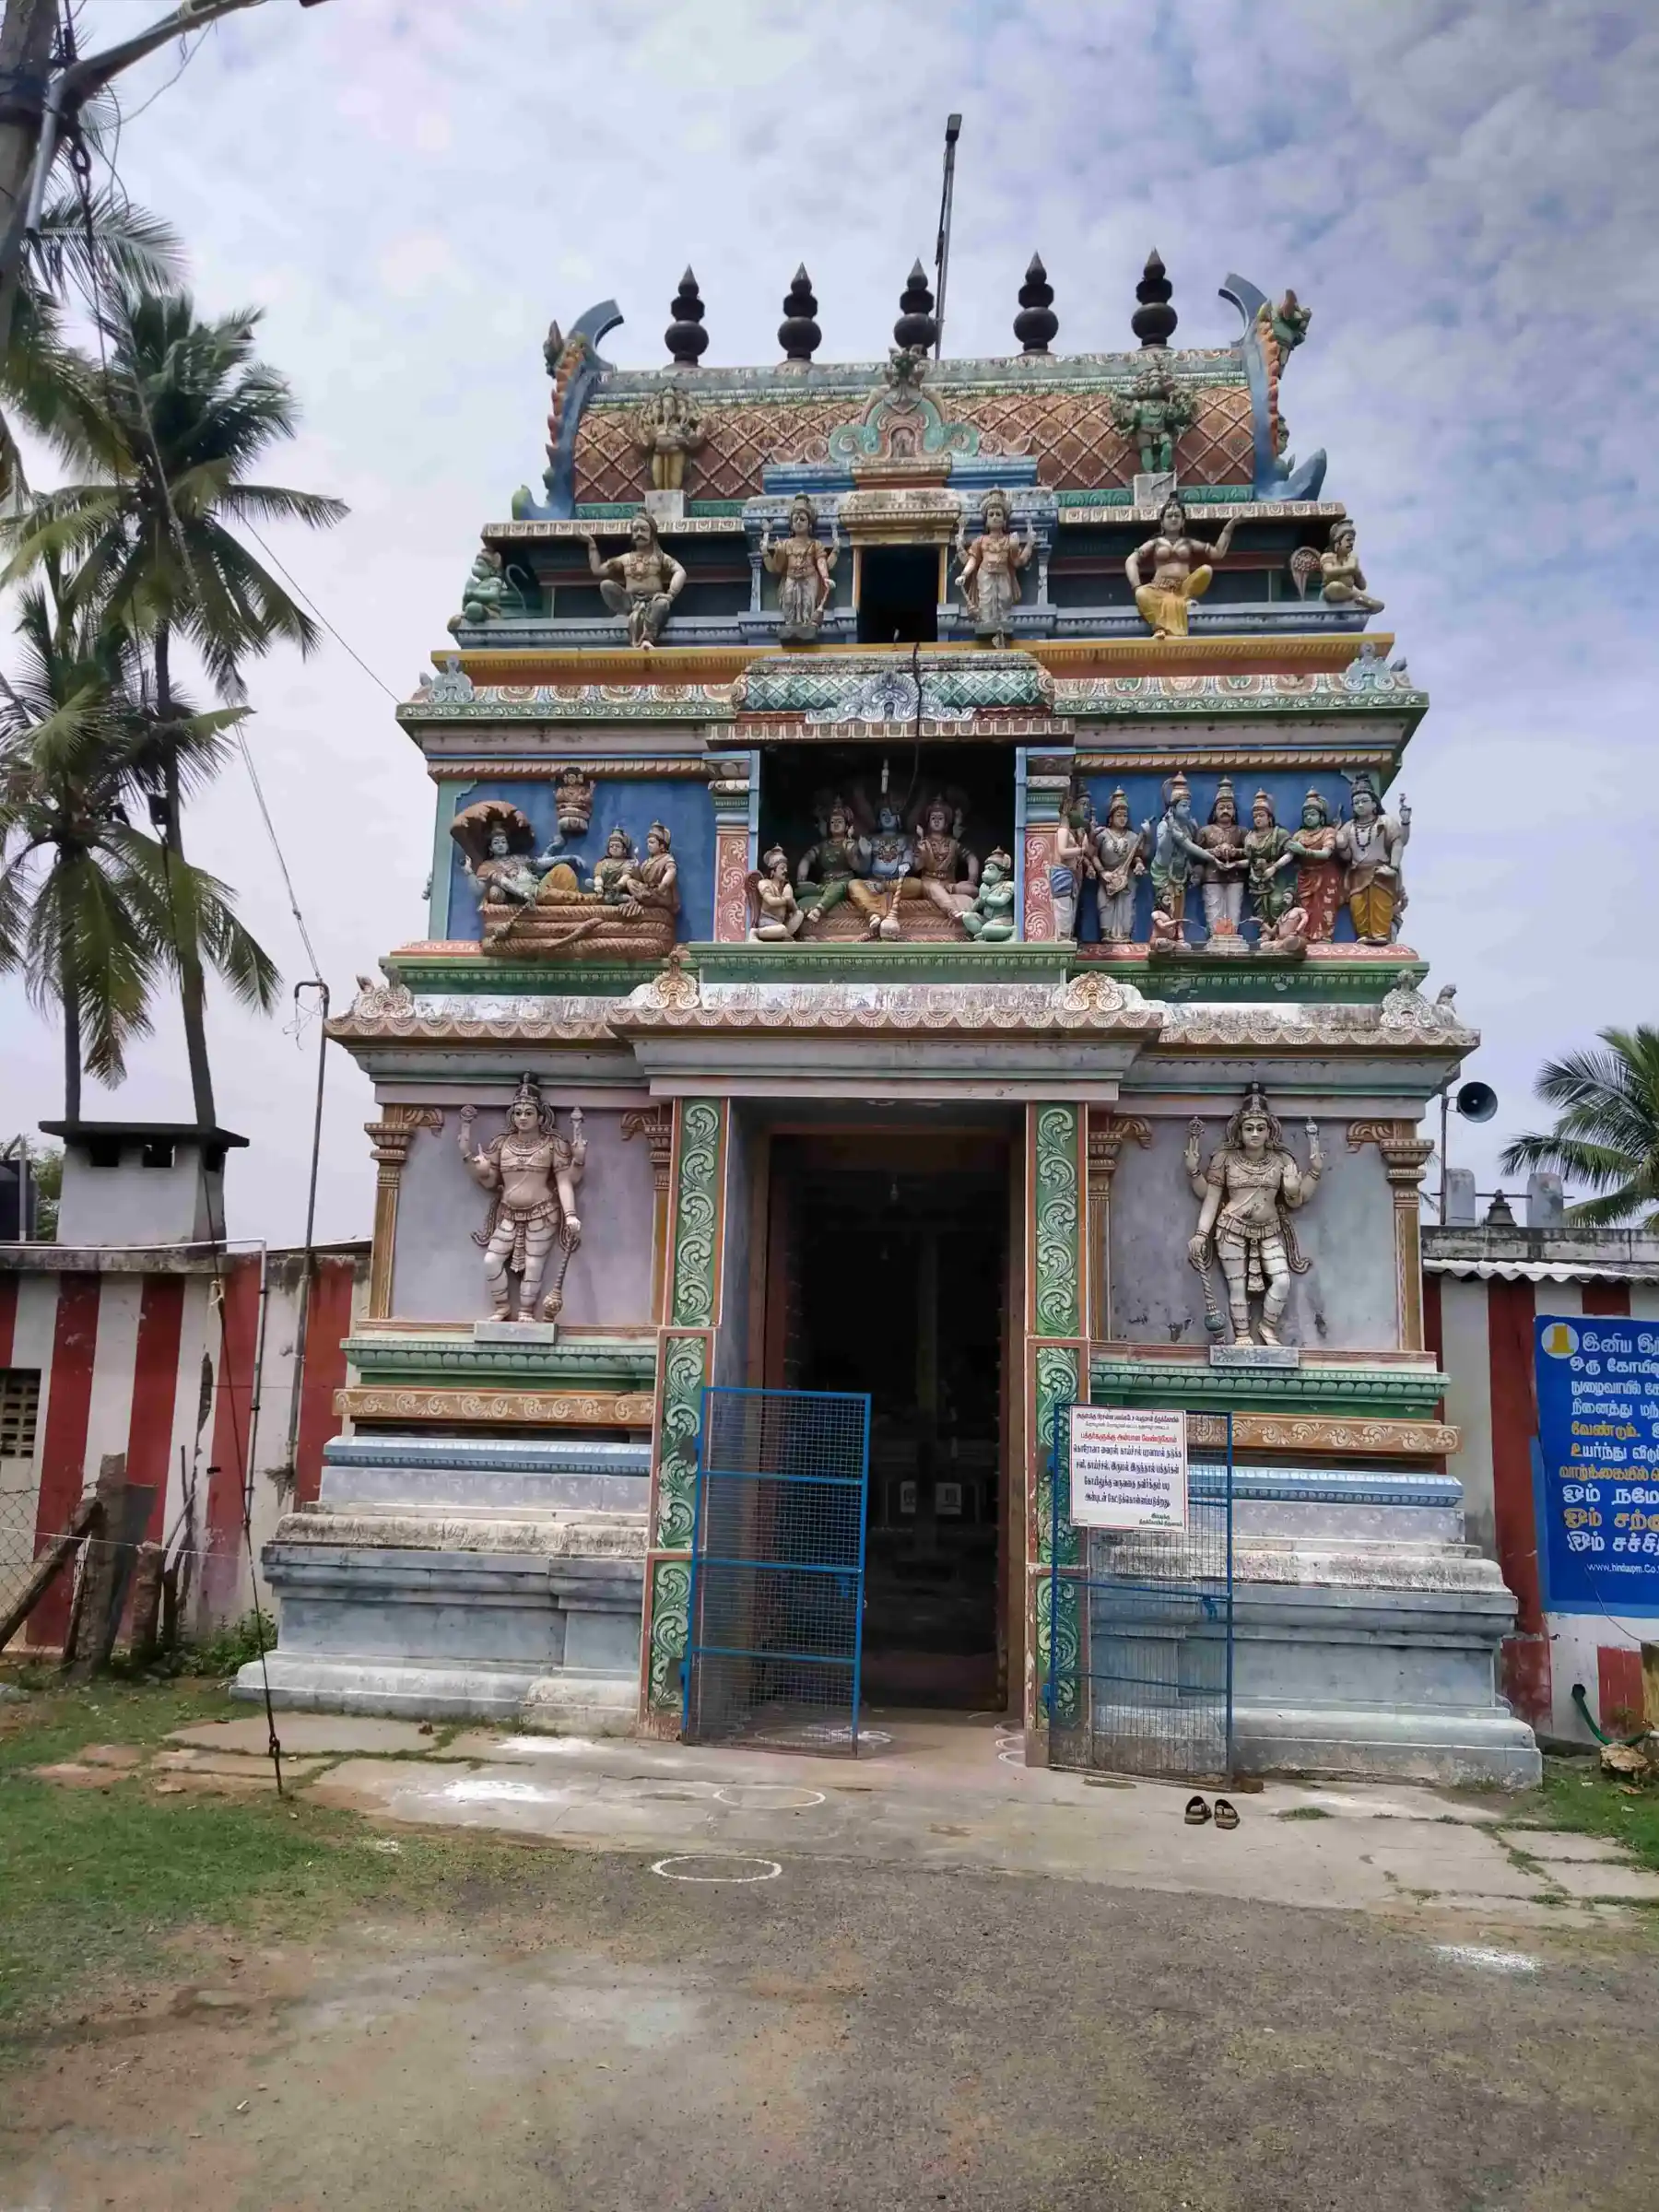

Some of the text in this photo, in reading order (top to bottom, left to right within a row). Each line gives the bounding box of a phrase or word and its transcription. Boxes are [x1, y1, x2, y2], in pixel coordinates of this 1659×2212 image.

[1583, 1332, 1632, 1353] இனிய
[1570, 1356, 1601, 1375] ஒரு
[1571, 1380, 1641, 1395] நுழைவாயில்
[1571, 1397, 1632, 1418] நினைந்து
[1571, 1420, 1641, 1440] வேண்டும்.
[1571, 1441, 1627, 1461] உயர்ந்து
[1559, 1463, 1649, 1481] வாழ்க்கையில்
[1563, 1483, 1600, 1503] ஓம்
[1564, 1507, 1602, 1528] ஓம்
[1567, 1531, 1605, 1551] ஓம்
